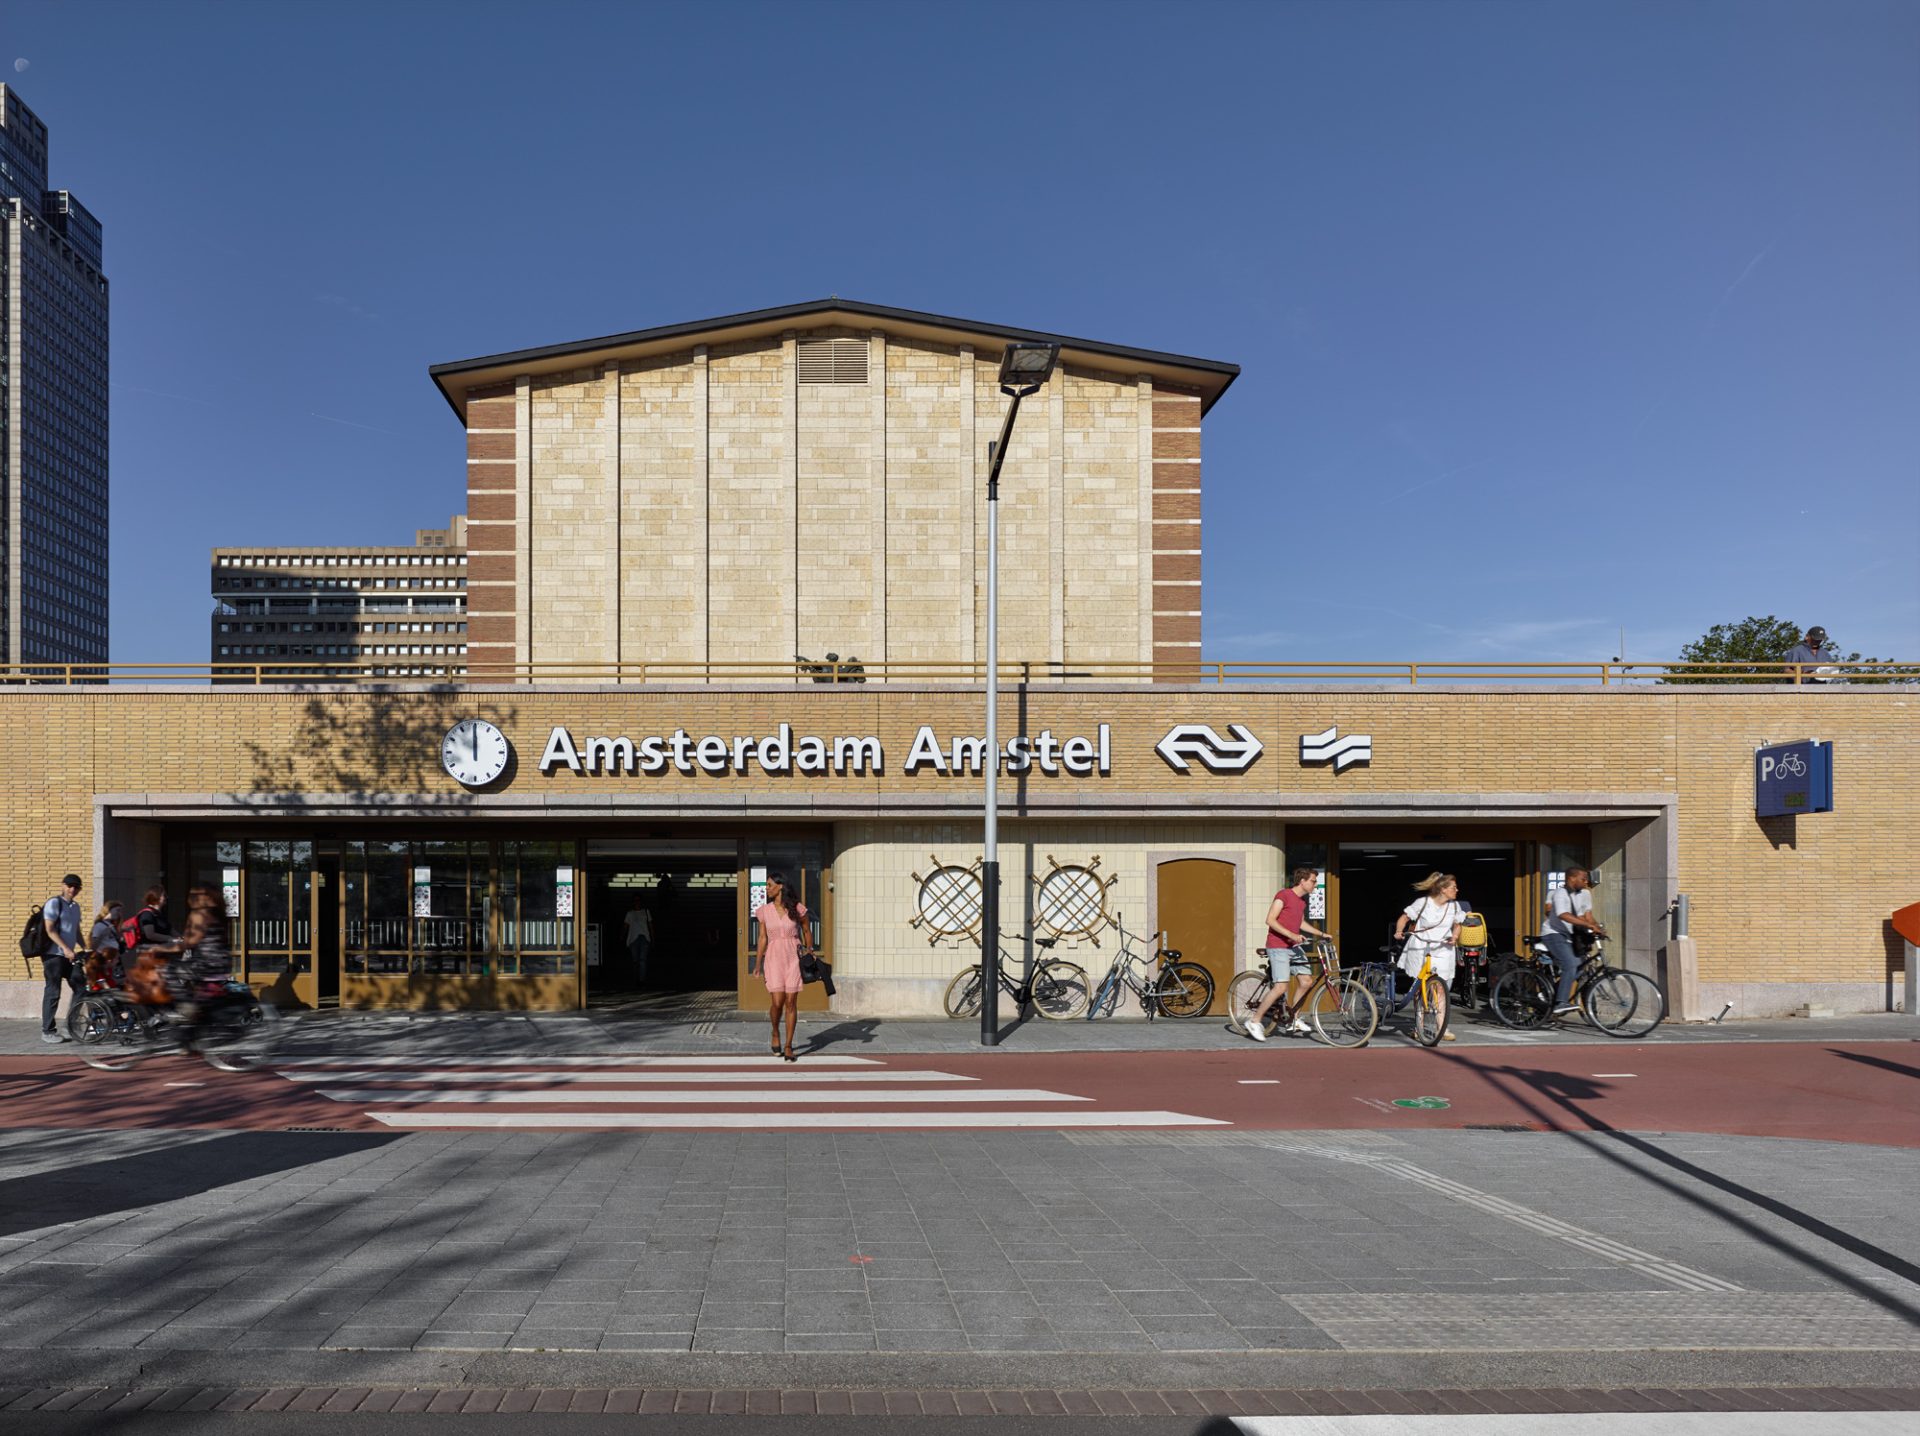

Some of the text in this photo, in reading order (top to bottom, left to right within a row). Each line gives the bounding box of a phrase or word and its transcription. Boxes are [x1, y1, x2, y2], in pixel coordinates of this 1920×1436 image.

[538, 723, 1110, 770] Amsterdam Amstel
[1762, 757, 1775, 782] P
